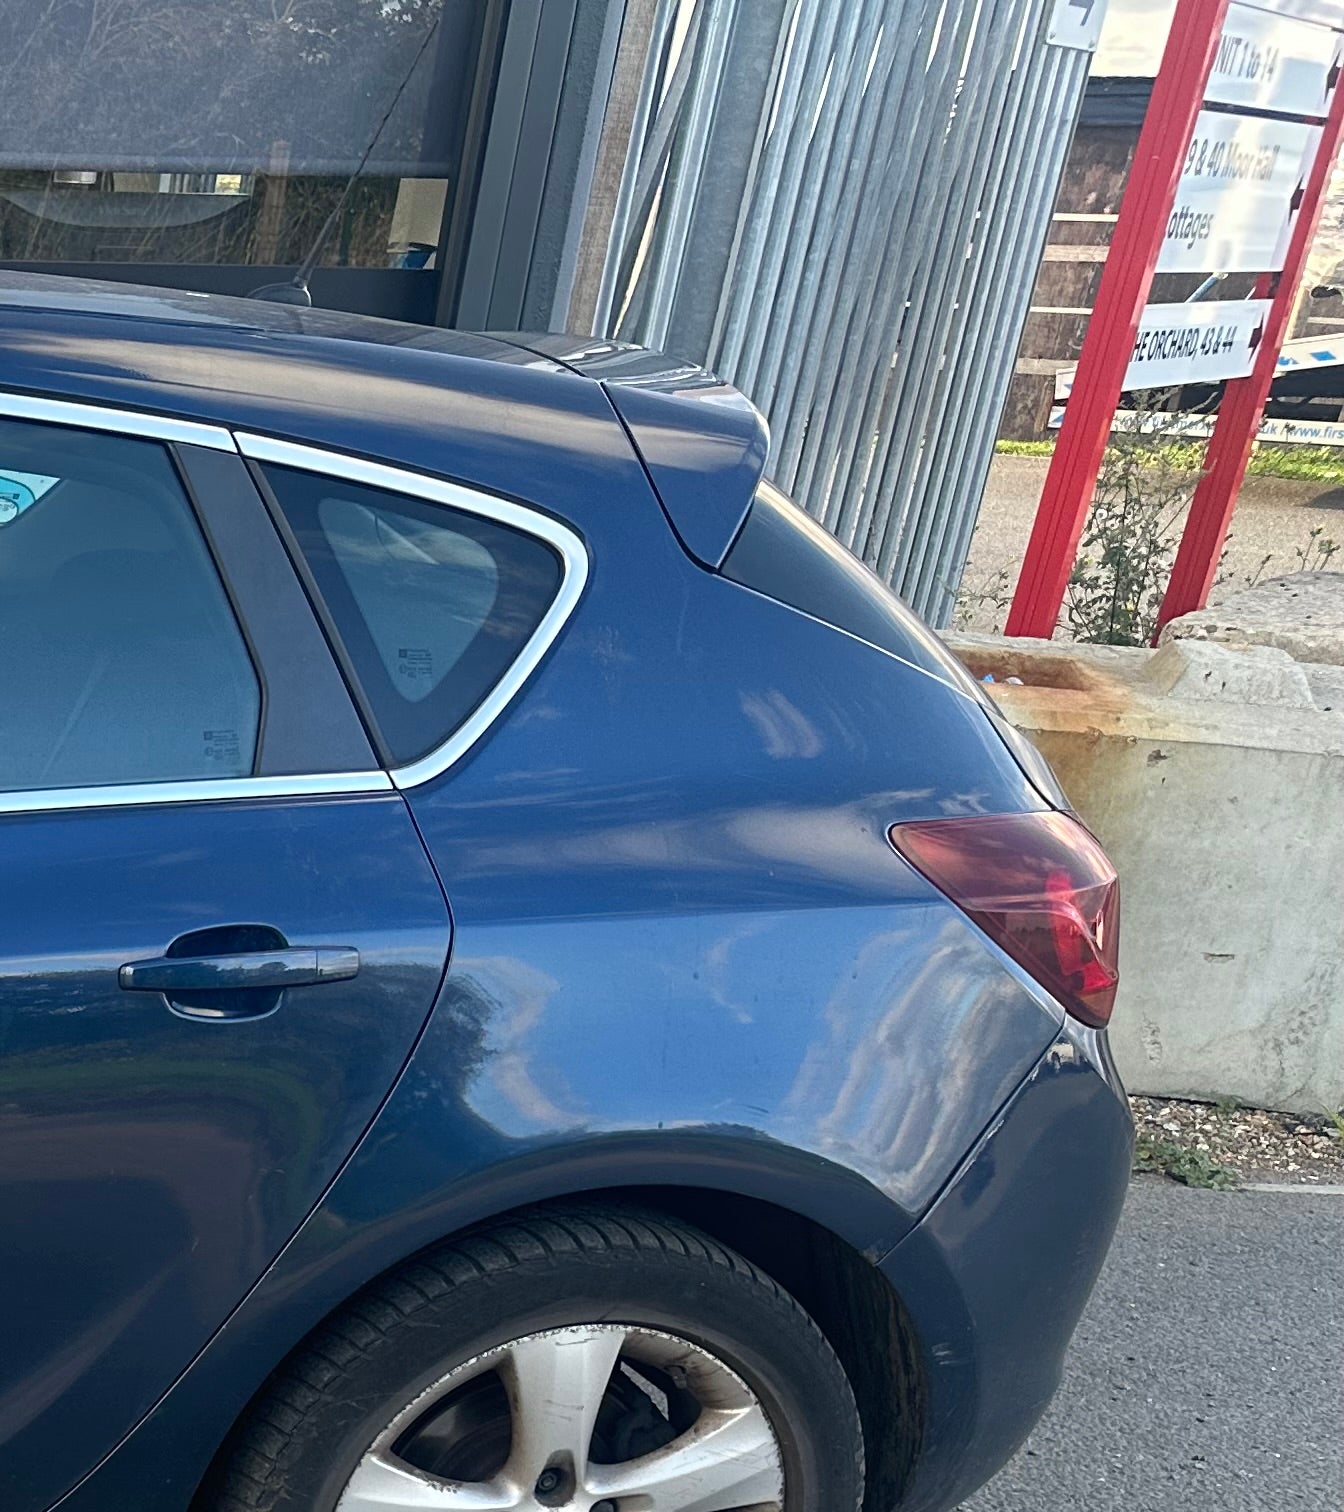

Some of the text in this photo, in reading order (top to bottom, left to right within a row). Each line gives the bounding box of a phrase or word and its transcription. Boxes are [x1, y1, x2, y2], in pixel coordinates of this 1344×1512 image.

[1214, 34, 1243, 76] NIT
[1237, 41, 1249, 77] 1
[1194, 138, 1209, 176] &
[1207, 141, 1226, 178] 40
[1167, 205, 1214, 250] ottages
[1222, 325, 1238, 353] 44
